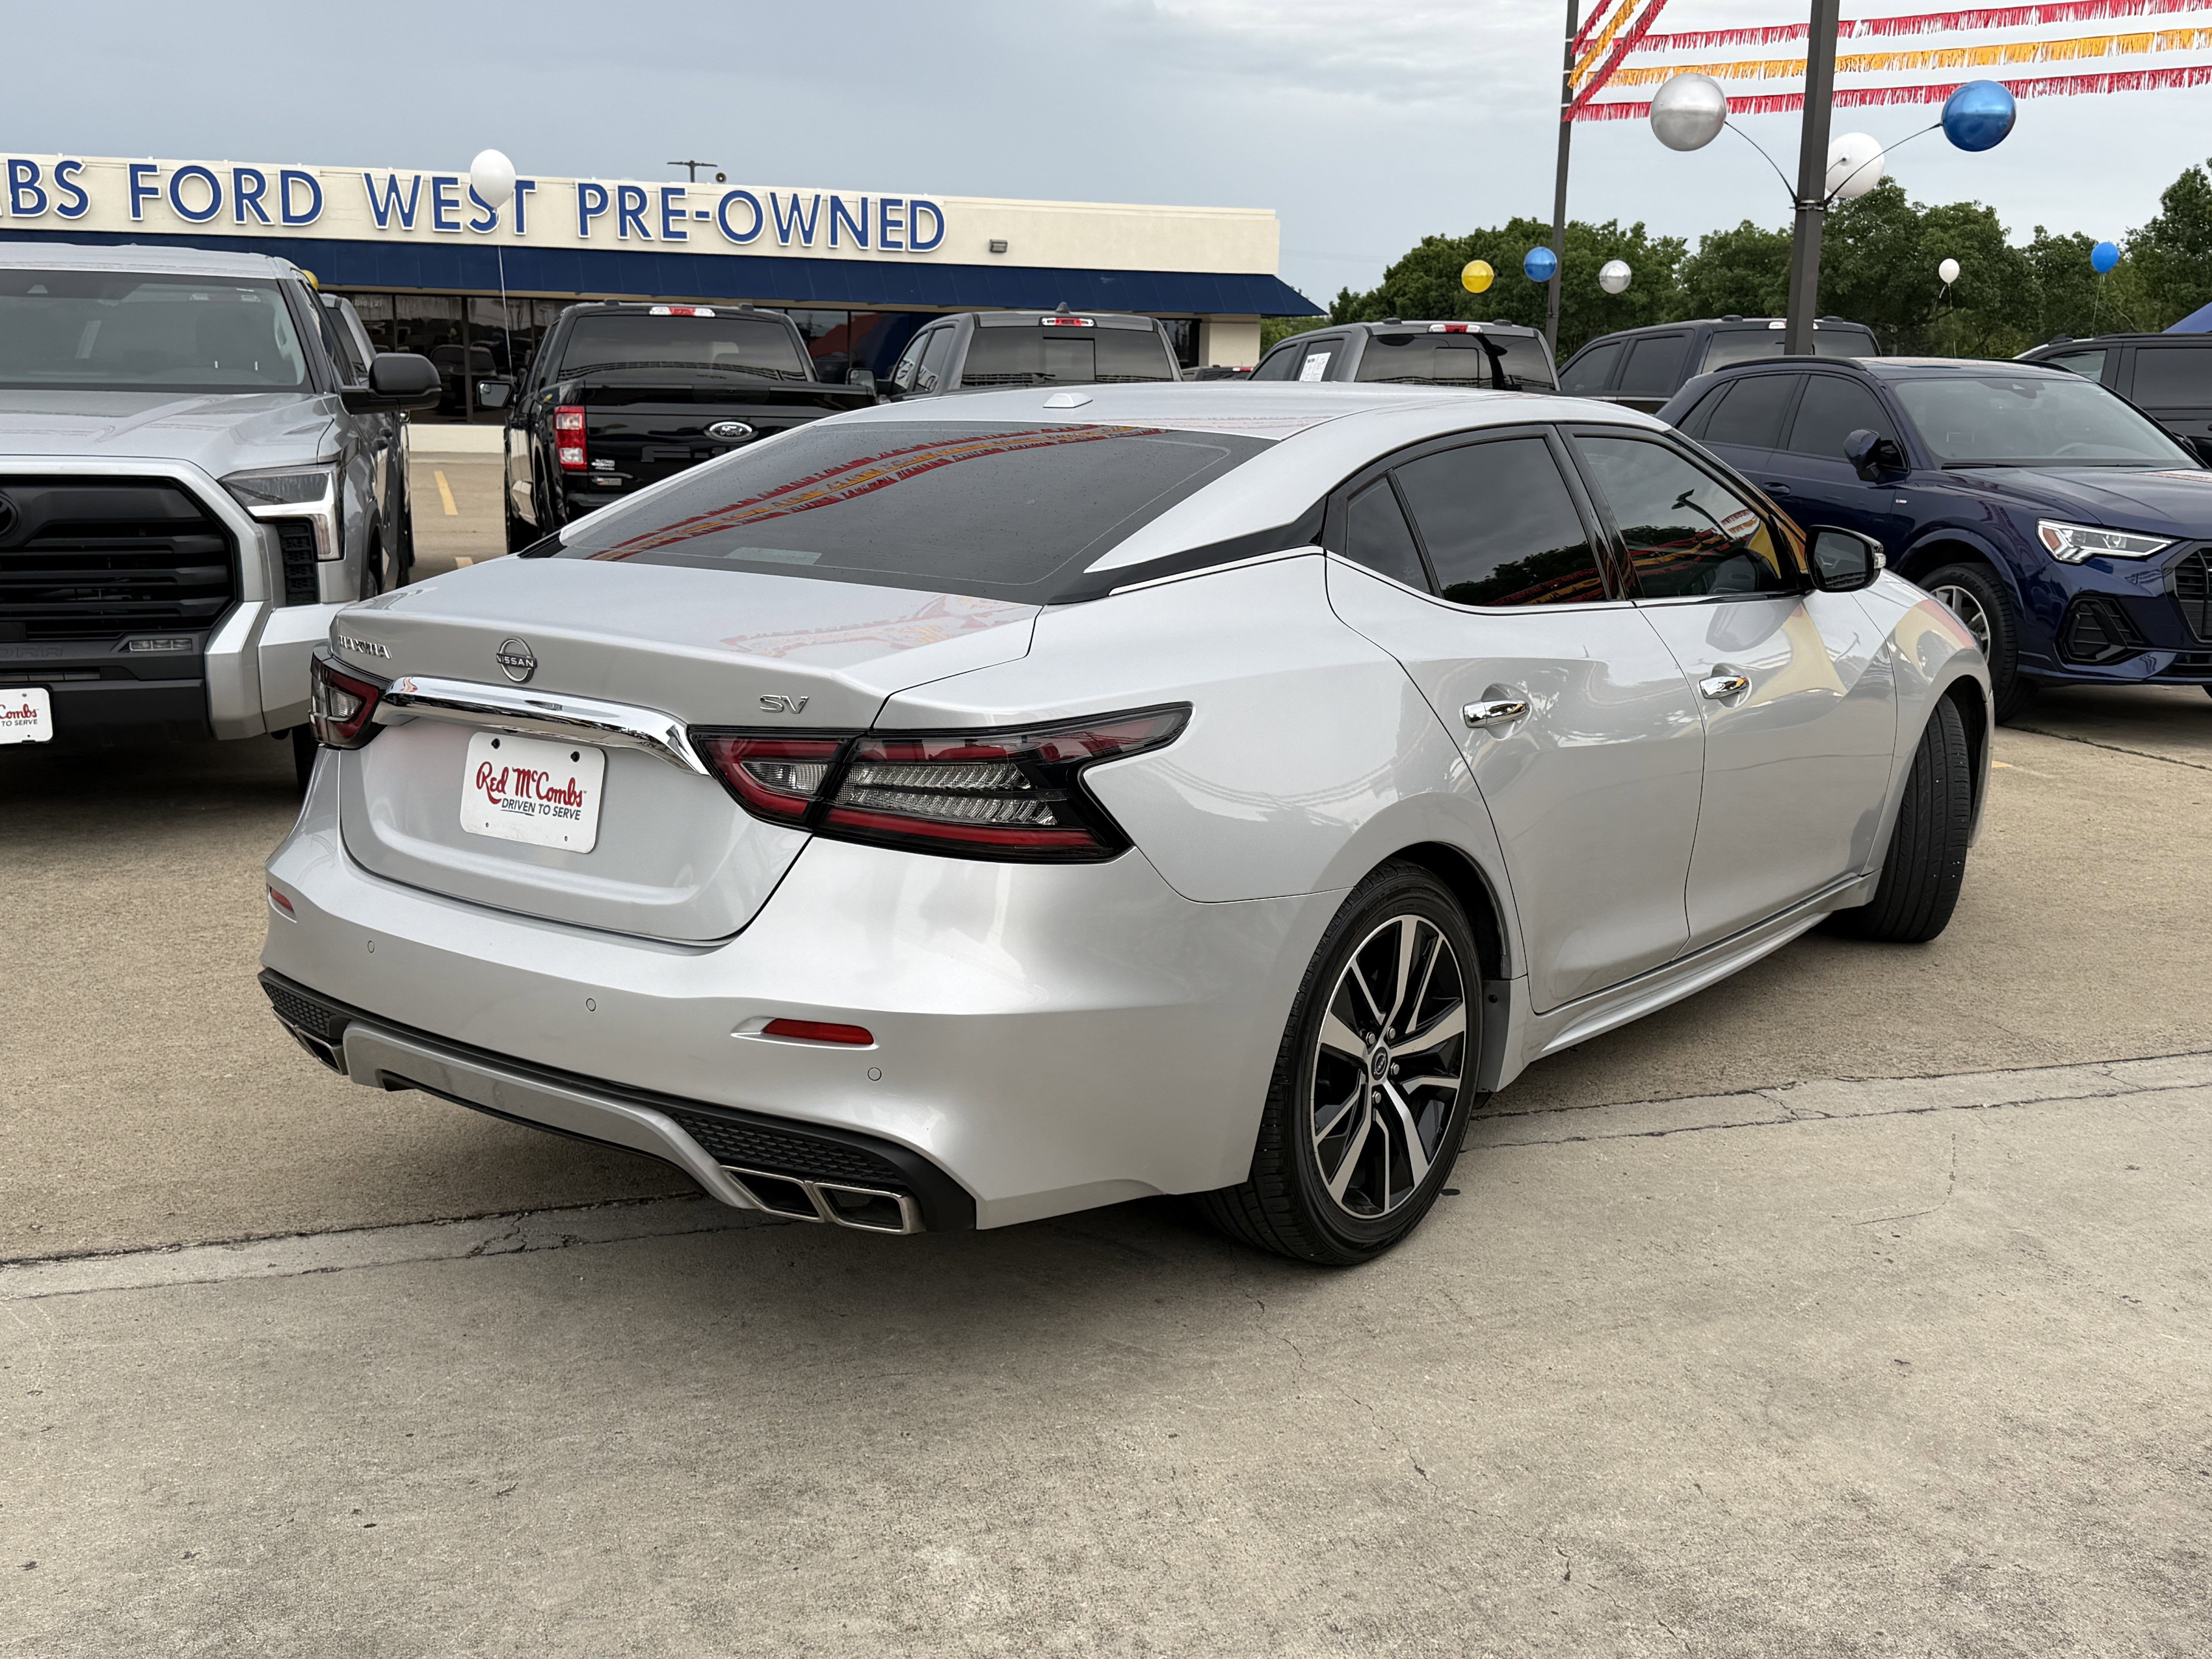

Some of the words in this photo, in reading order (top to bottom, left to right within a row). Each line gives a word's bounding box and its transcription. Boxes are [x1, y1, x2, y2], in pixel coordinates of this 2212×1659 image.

[0, 158, 91, 219] BS
[129, 163, 325, 225] FORD
[362, 173, 537, 235] WEST
[576, 182, 946, 252] PRE-OWNED
[719, 426, 742, 436] Ford
[497, 655, 534, 667] NISSAN
[760, 694, 809, 714] SV
[476, 761, 509, 804] Red
[512, 766, 582, 807] McCombs
[501, 798, 536, 813] DRIVEN
[539, 804, 550, 816] TO
[553, 806, 582, 821] SERVE
